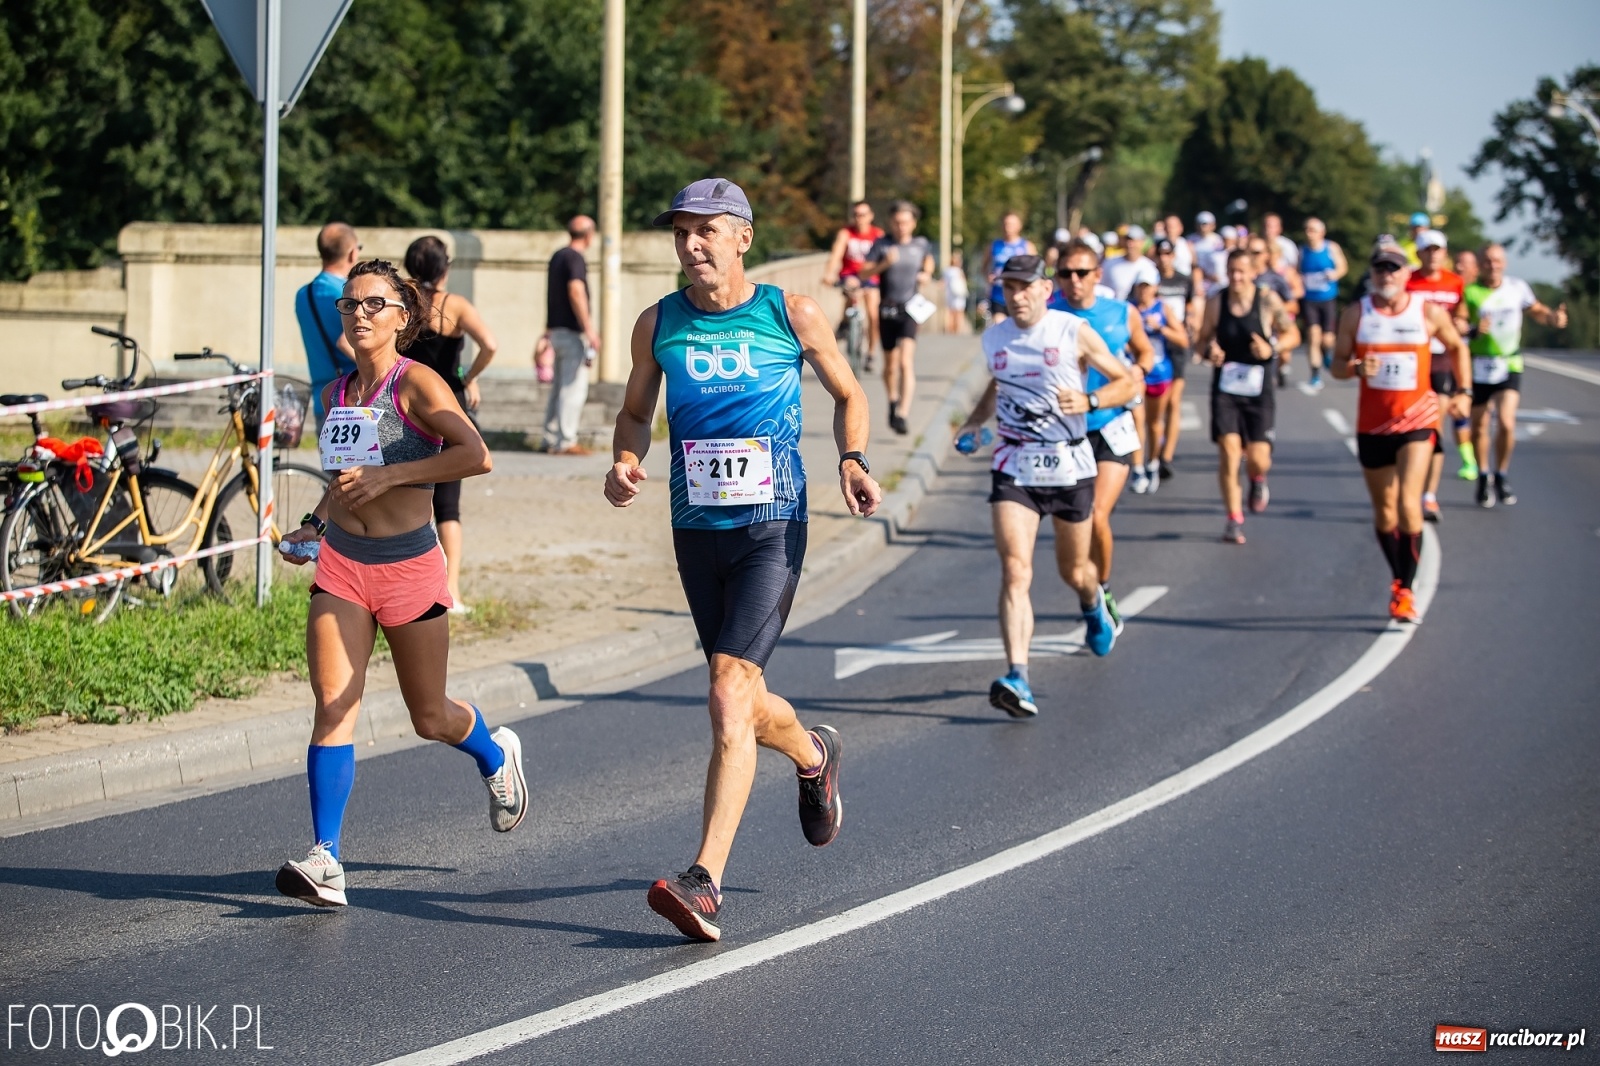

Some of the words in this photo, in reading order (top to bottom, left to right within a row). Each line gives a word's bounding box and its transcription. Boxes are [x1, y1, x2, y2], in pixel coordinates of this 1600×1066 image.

[685, 343, 759, 381] bbl
[701, 384, 746, 394] RACIBÓRZ
[330, 424, 361, 444] 239
[709, 457, 749, 478] 217
[1033, 455, 1060, 468] 209
